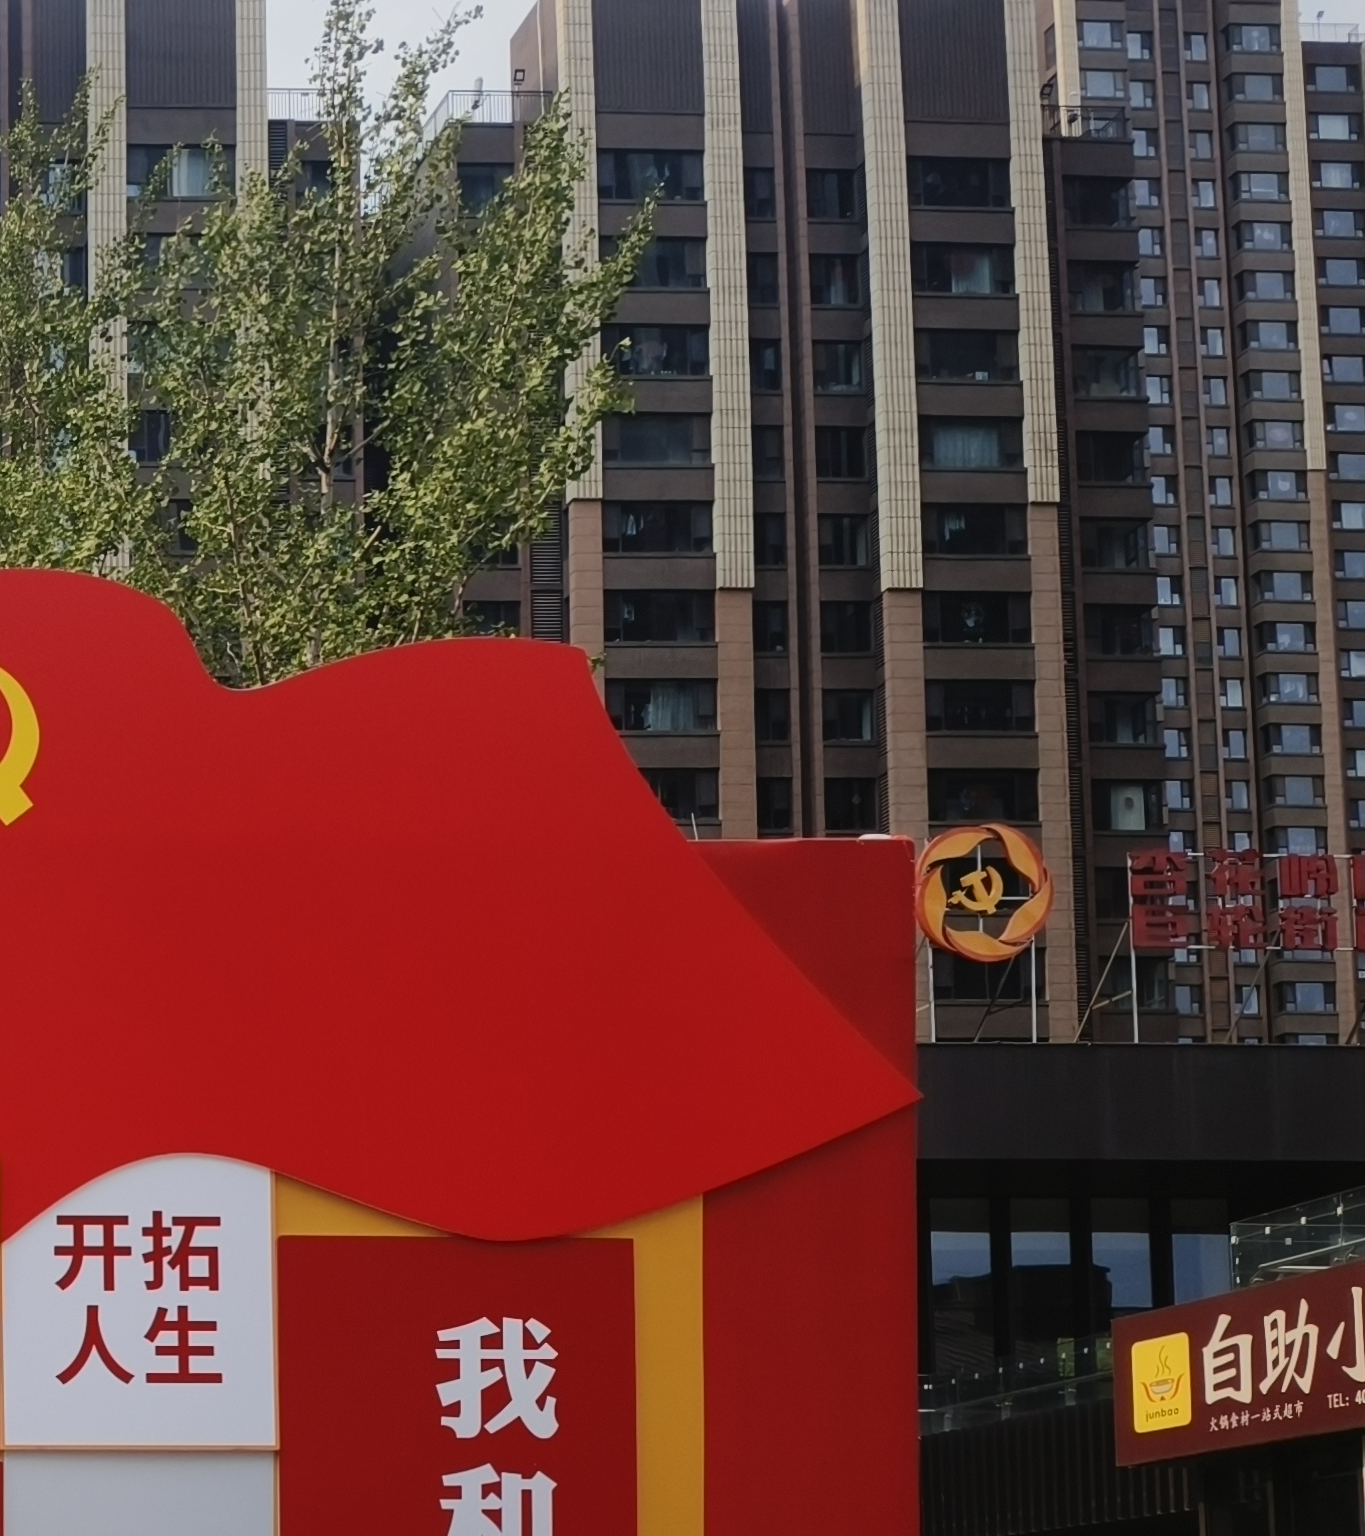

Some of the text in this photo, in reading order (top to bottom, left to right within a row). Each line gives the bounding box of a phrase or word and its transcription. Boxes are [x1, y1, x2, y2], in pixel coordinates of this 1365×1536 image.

[1131, 848, 1365, 898] 杏花岭
[1131, 904, 1365, 950] 巨轮街
[53, 1210, 223, 1292] 开拓
[54, 1304, 224, 1385] 人生
[1145, 1406, 1180, 1423] junbao
[1326, 1392, 1350, 1409] TEL:
